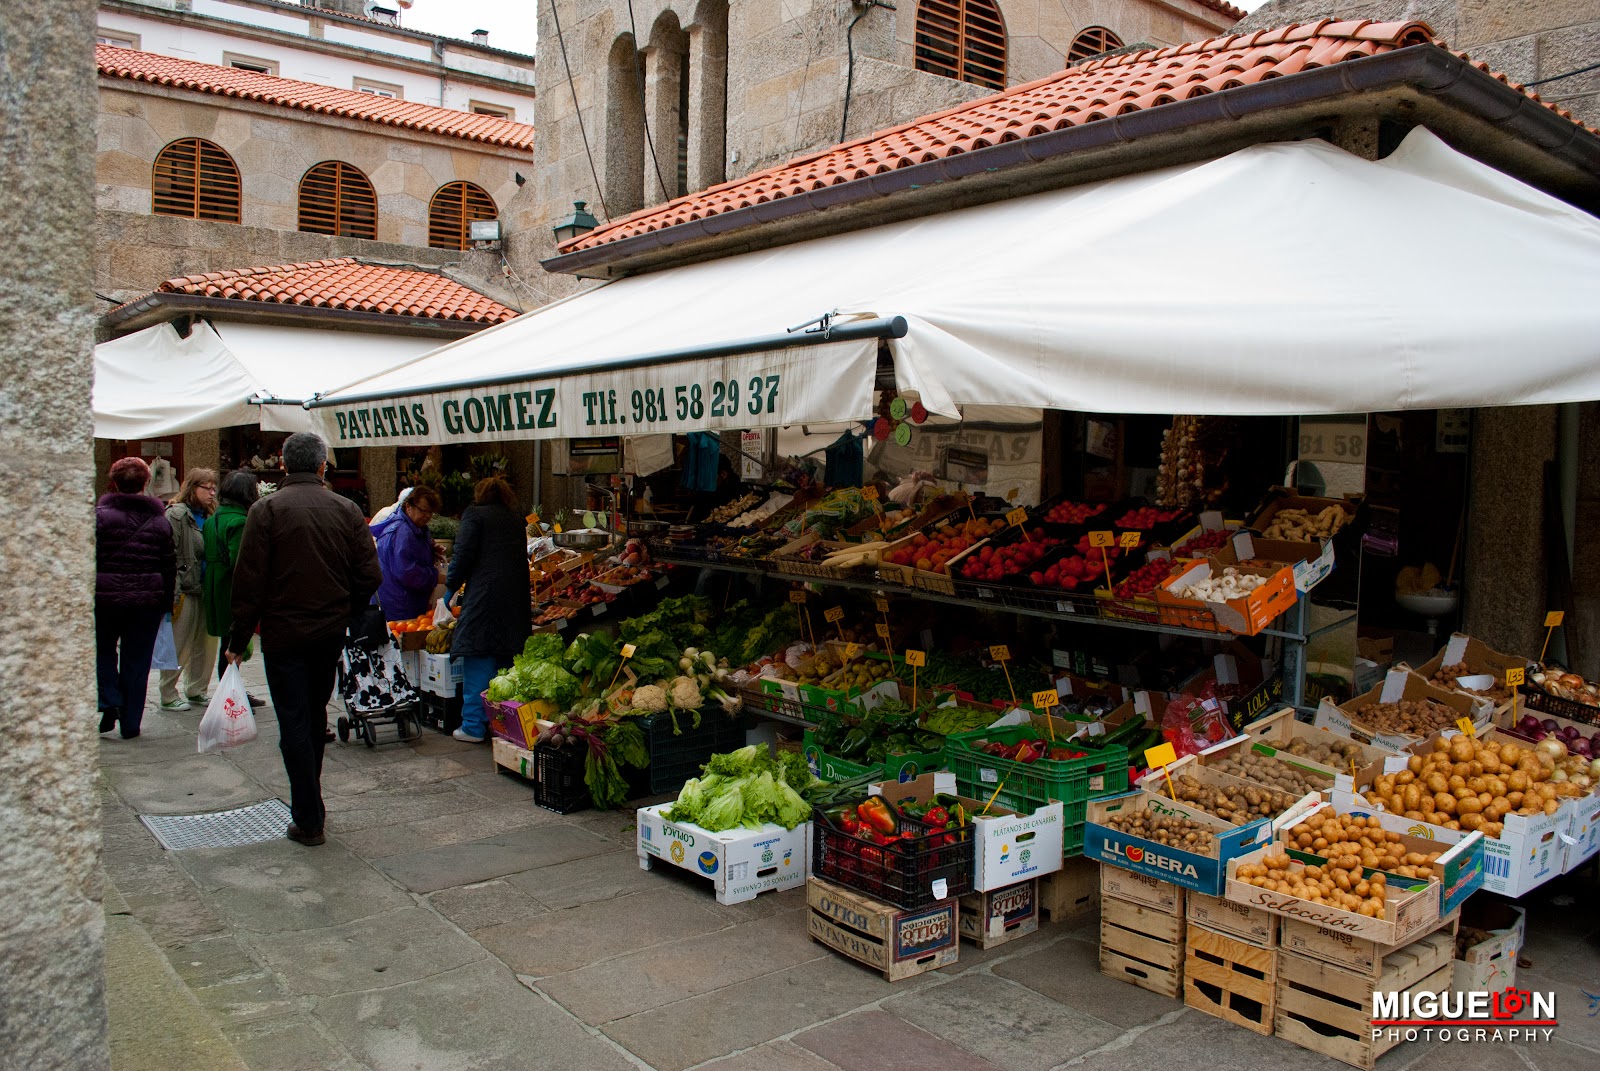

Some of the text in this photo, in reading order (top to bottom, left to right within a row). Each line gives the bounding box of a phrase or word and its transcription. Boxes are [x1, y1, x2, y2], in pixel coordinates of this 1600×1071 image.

[335, 375, 780, 440] PATATAS GOMEZ Tlf. 981 58 29 37
[743, 433, 760, 441] OFERTA
[1097, 533, 1106, 545] 3
[1247, 688, 1270, 717] LOLA
[993, 814, 1057, 838] PLÁTANOS DE CANARIAS
[733, 882, 761, 895] CANARIAS
[1130, 871, 1158, 888] esther
[993, 892, 1030, 912] BOLLO
[1217, 898, 1250, 914] esther
[1249, 892, 1364, 932] Selección
[820, 897, 868, 931] BOLLO
[902, 913, 949, 931] TRADICIÓN
[811, 917, 882, 961] NARANJAS
[902, 921, 949, 942] BOLLO
[1317, 926, 1353, 944] esther
